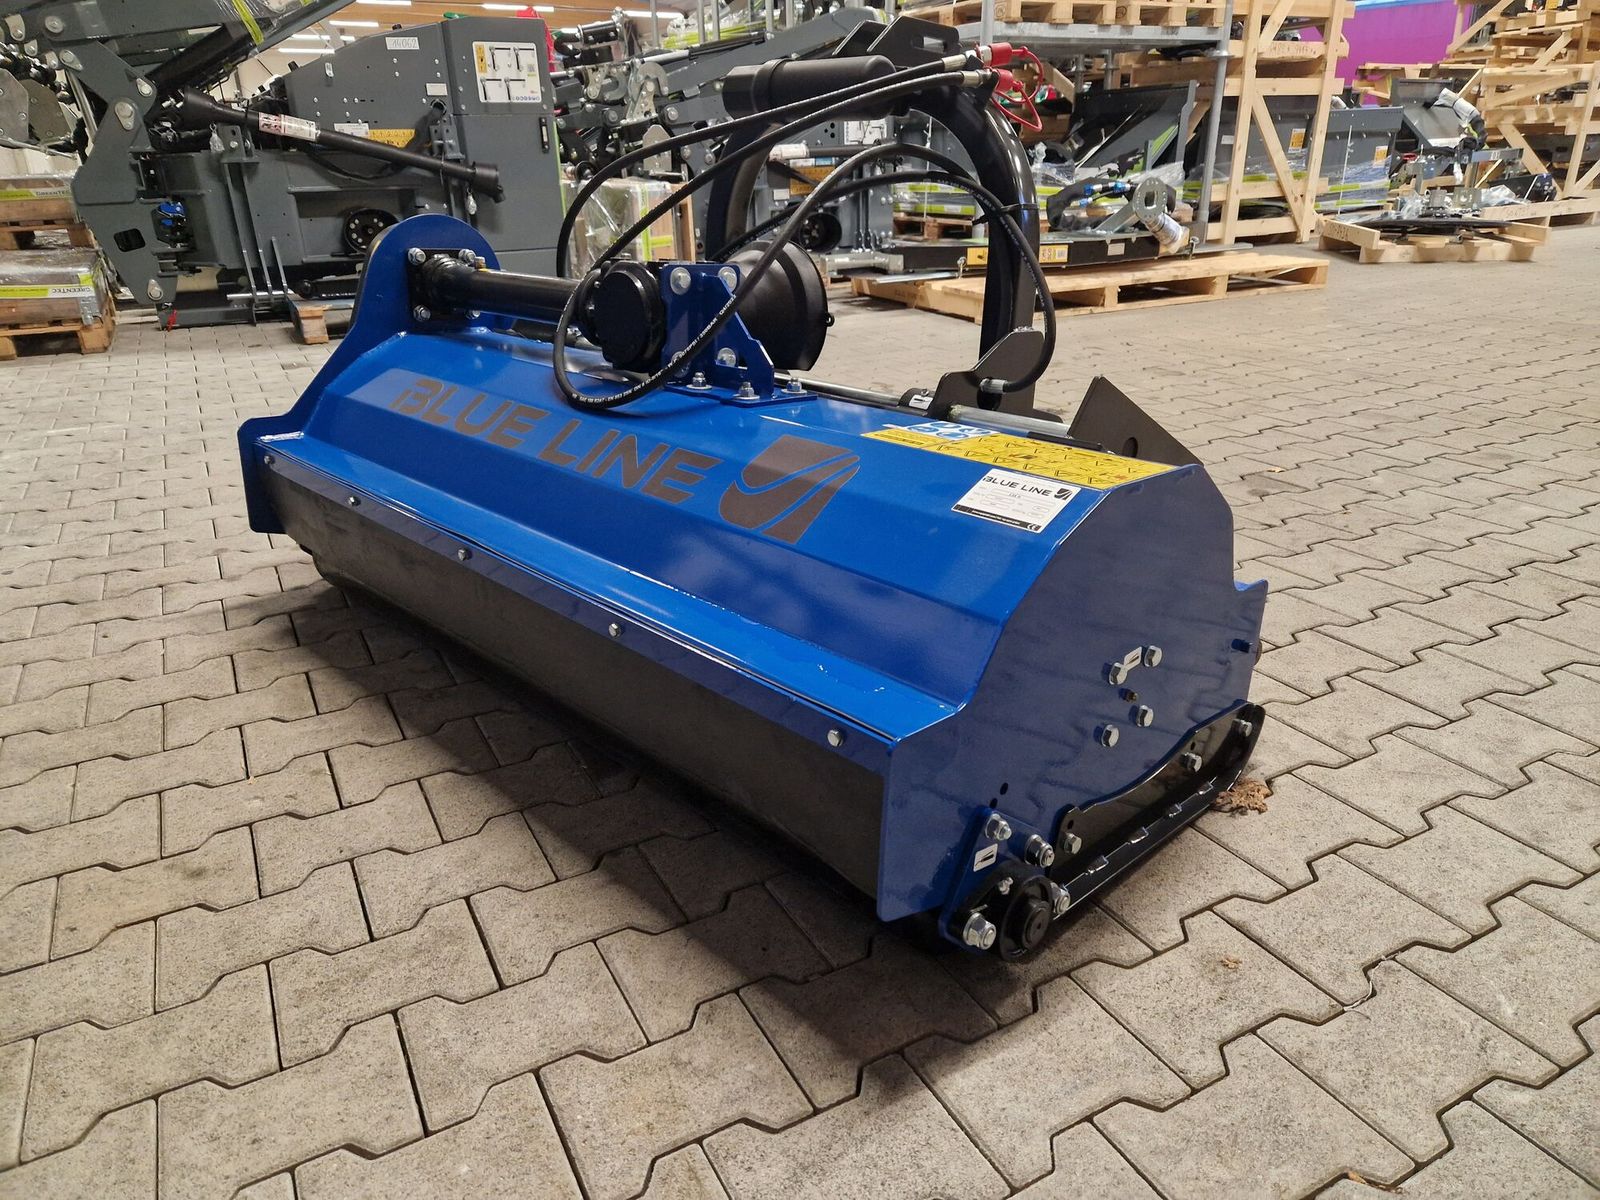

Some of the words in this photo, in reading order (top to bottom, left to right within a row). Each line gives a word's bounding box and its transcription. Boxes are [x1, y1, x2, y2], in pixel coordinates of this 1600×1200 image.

[389, 378, 550, 449] BLUE
[535, 418, 723, 504] LINE
[982, 475, 1019, 489] BLUE
[1020, 484, 1053, 497] LINE
